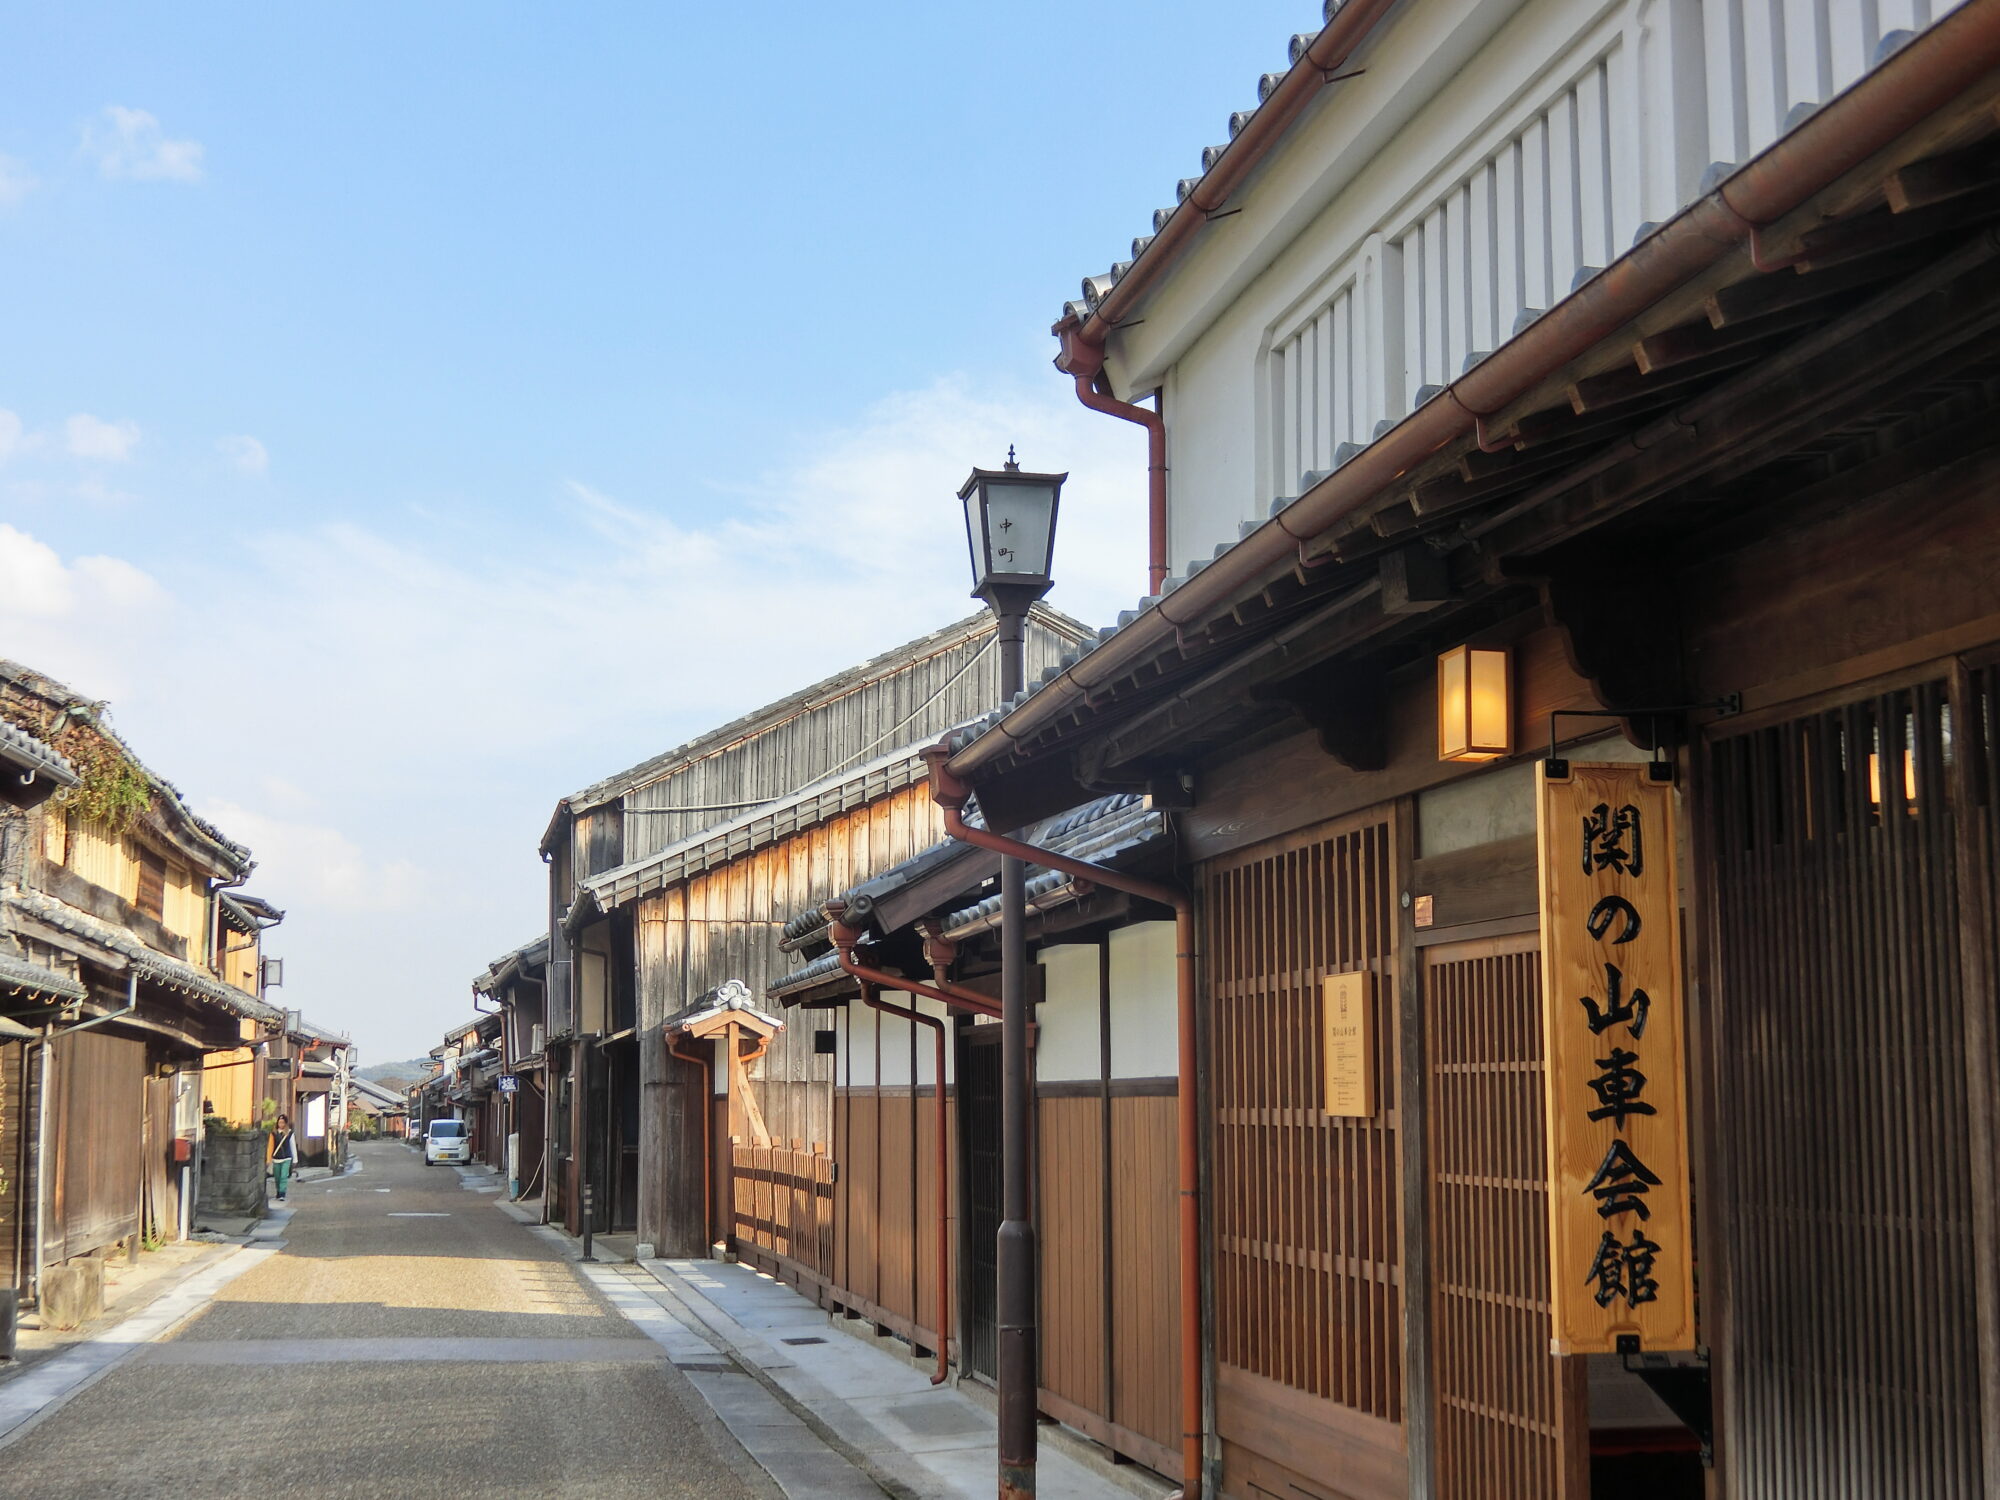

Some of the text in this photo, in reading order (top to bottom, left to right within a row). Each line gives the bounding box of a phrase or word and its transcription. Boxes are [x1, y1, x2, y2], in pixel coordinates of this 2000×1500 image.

[998, 518, 1014, 562] 中町
[1580, 803, 1663, 1309] 関の山車会館
